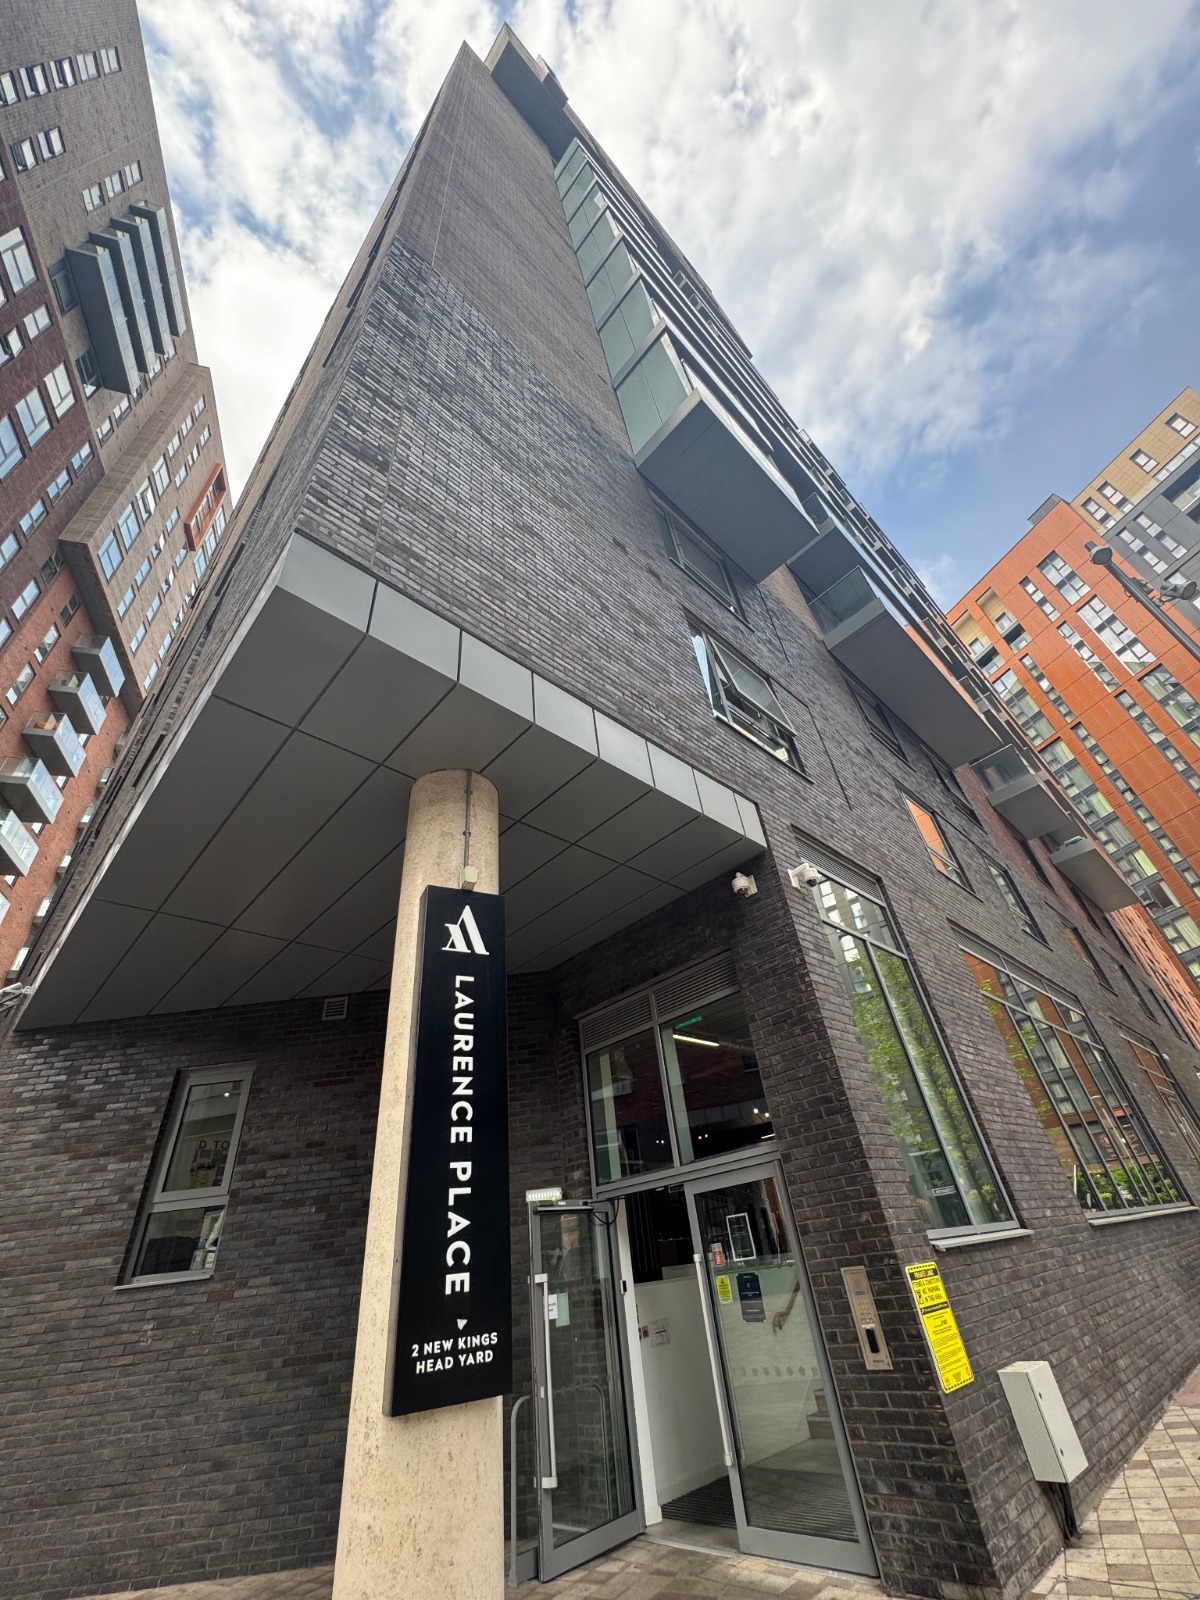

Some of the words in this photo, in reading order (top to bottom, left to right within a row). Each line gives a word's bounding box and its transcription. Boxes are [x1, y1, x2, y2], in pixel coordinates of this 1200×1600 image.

[450, 974, 475, 1144] LAURENCE
[445, 1161, 473, 1295] PLACE
[411, 1343, 419, 1357] 2
[423, 1338, 454, 1356] NEW
[458, 1332, 498, 1350] KINGS
[416, 1356, 454, 1374] HEAD
[458, 1349, 494, 1367] YARD
